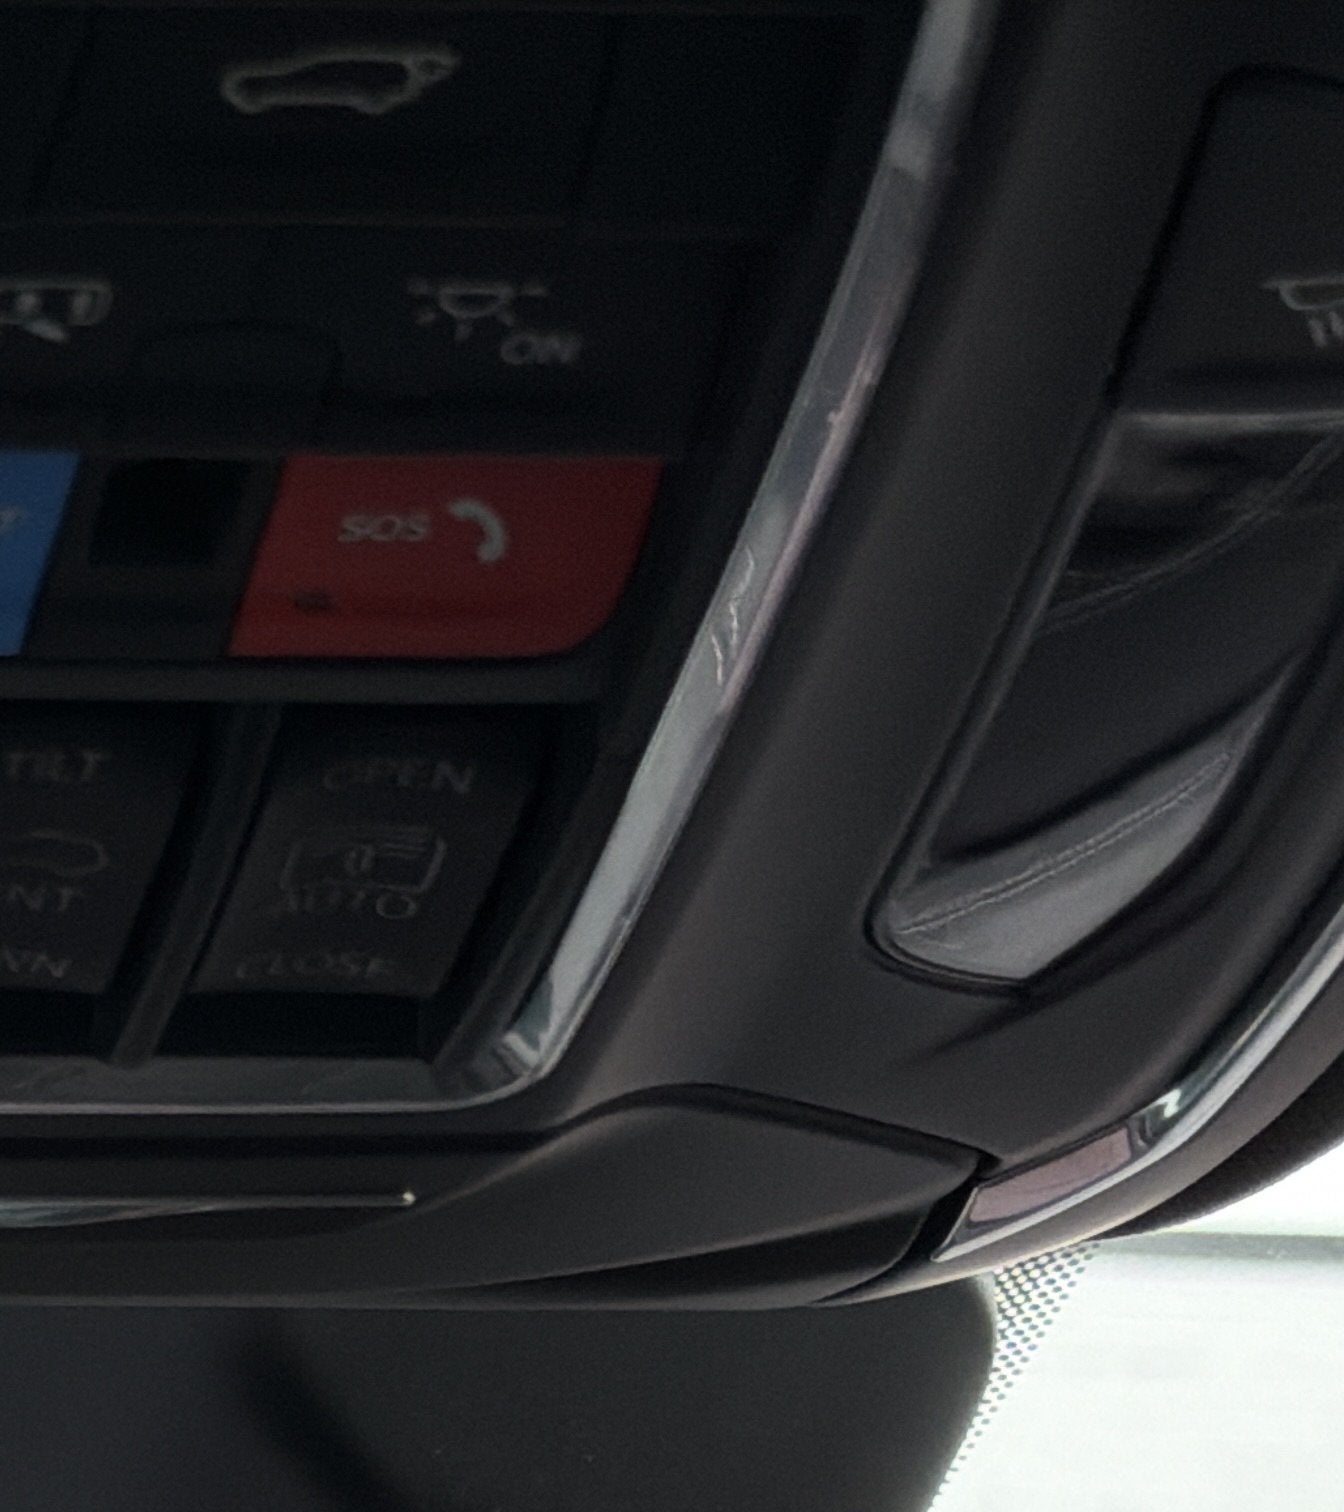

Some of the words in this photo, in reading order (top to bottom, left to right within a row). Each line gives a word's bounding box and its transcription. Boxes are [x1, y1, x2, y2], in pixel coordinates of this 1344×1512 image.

[499, 330, 584, 366] ON
[337, 513, 433, 544] SOS
[5, 746, 111, 782] TILT
[321, 757, 478, 795] OPEN
